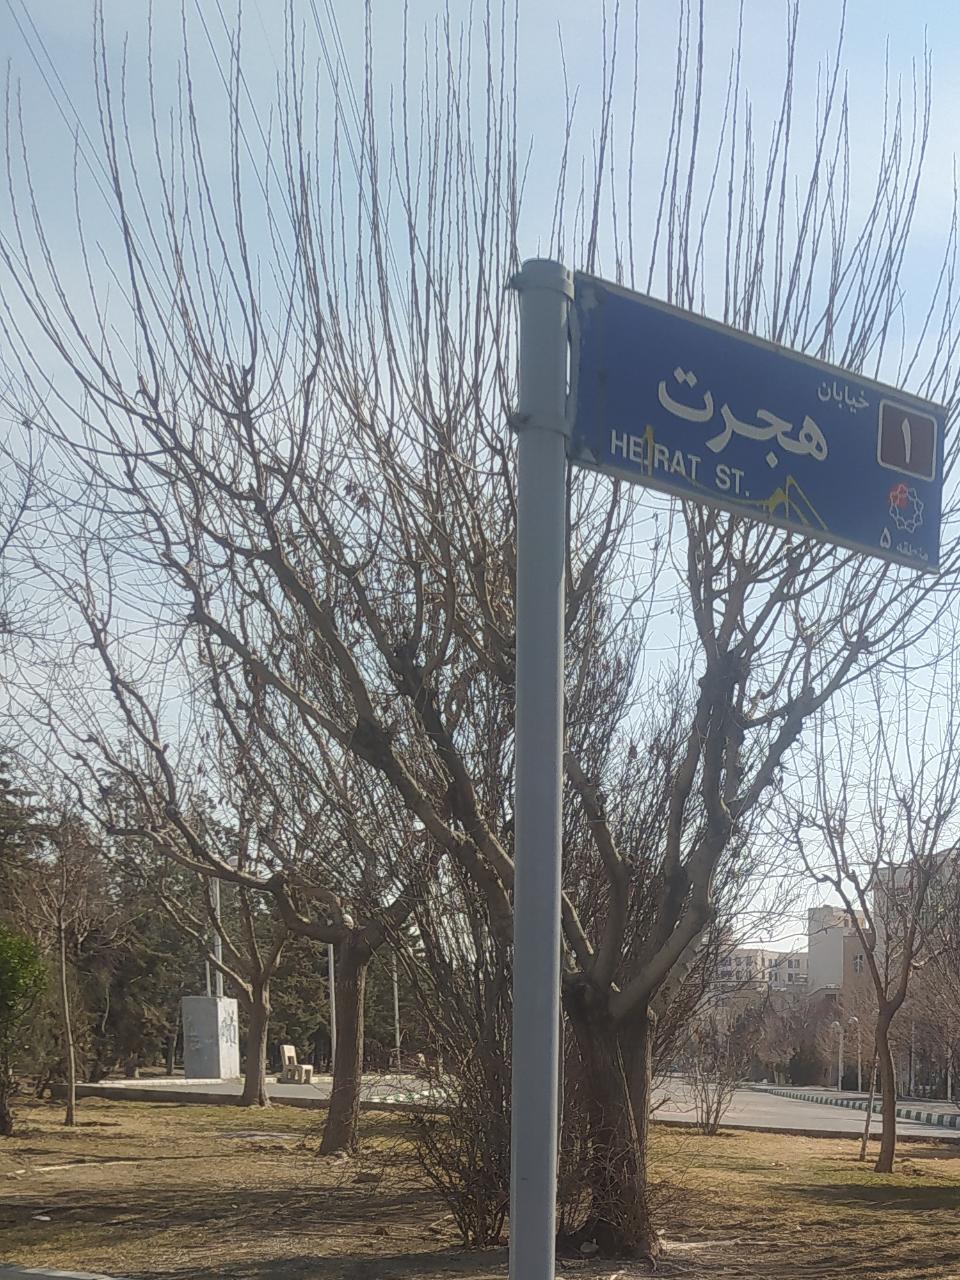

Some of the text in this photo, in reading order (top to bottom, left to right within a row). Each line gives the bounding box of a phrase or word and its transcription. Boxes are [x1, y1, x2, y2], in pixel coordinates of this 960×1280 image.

[817, 381, 870, 415] خیابان
[658, 366, 829, 469] هجرت
[715, 463, 750, 497] ST.
[880, 527, 892, 549] ۵
